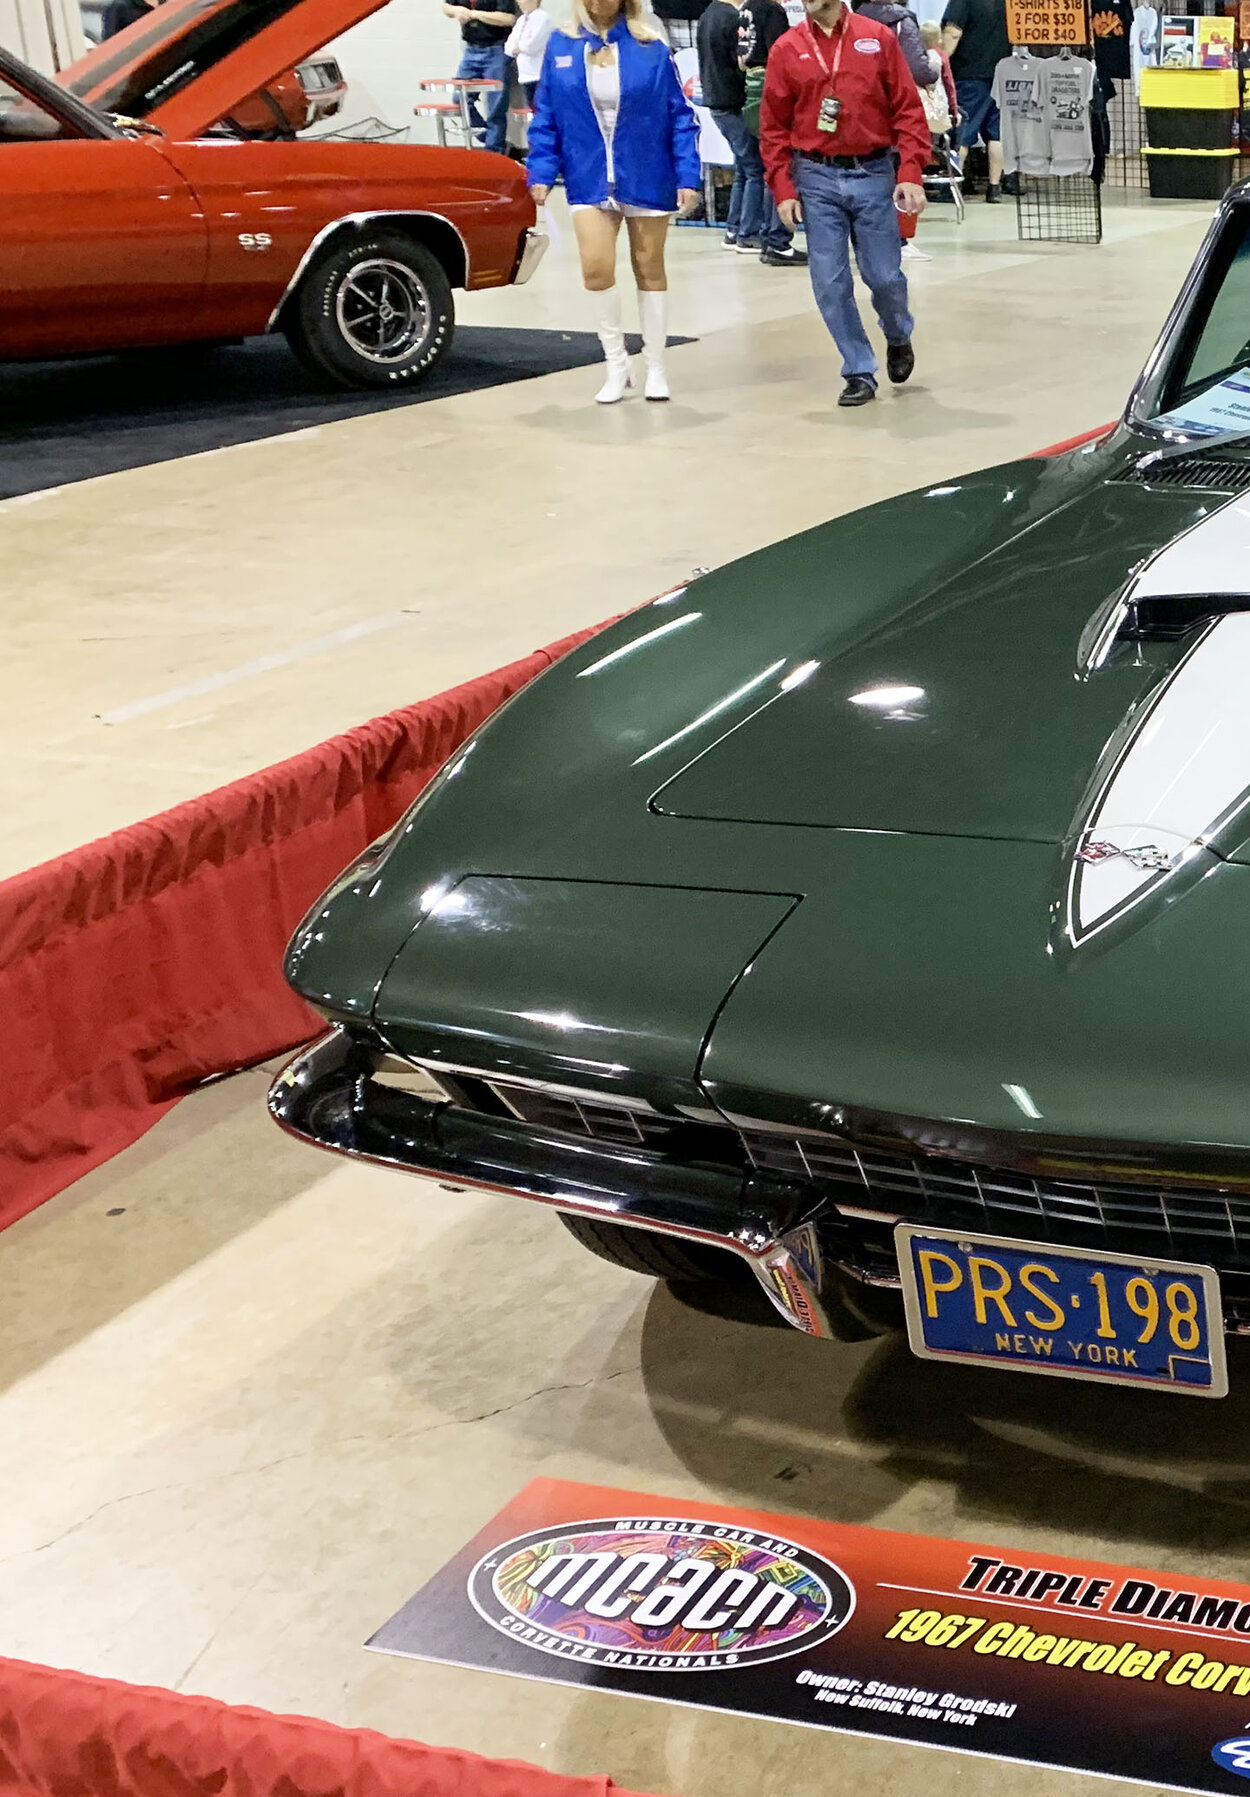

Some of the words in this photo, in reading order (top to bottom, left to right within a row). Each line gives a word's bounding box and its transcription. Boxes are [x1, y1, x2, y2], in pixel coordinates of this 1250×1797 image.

[1015, 13, 1021, 25] 2
[1025, 13, 1050, 25] FOR
[1053, 12, 1075, 26] $30
[1016, 28, 1022, 40] 3
[1025, 28, 1050, 40] FOR
[1053, 28, 1076, 41] $40
[238, 233, 273, 246] SS
[388, 314, 448, 381] GOODYEAR
[995, 1332, 1053, 1357] NEW
[1068, 1340, 1139, 1369] YORK
[614, 1520, 703, 1535] MUSCLE
[713, 1527, 752, 1544] CAR
[758, 1540, 800, 1558] AND
[499, 1614, 596, 1660] CORVETTE
[603, 1652, 740, 1669] NATIONALS
[884, 1608, 988, 1650] 1967
[974, 1621, 1173, 1680] Chevrolet
[795, 1670, 863, 1693] Owner:
[863, 1680, 938, 1706] Stanley
[938, 1692, 1017, 1718] Grodski
[814, 1689, 850, 1705] New
[849, 1694, 905, 1715] Suffolk,
[907, 1703, 944, 1721] New
[943, 1709, 978, 1726] York
